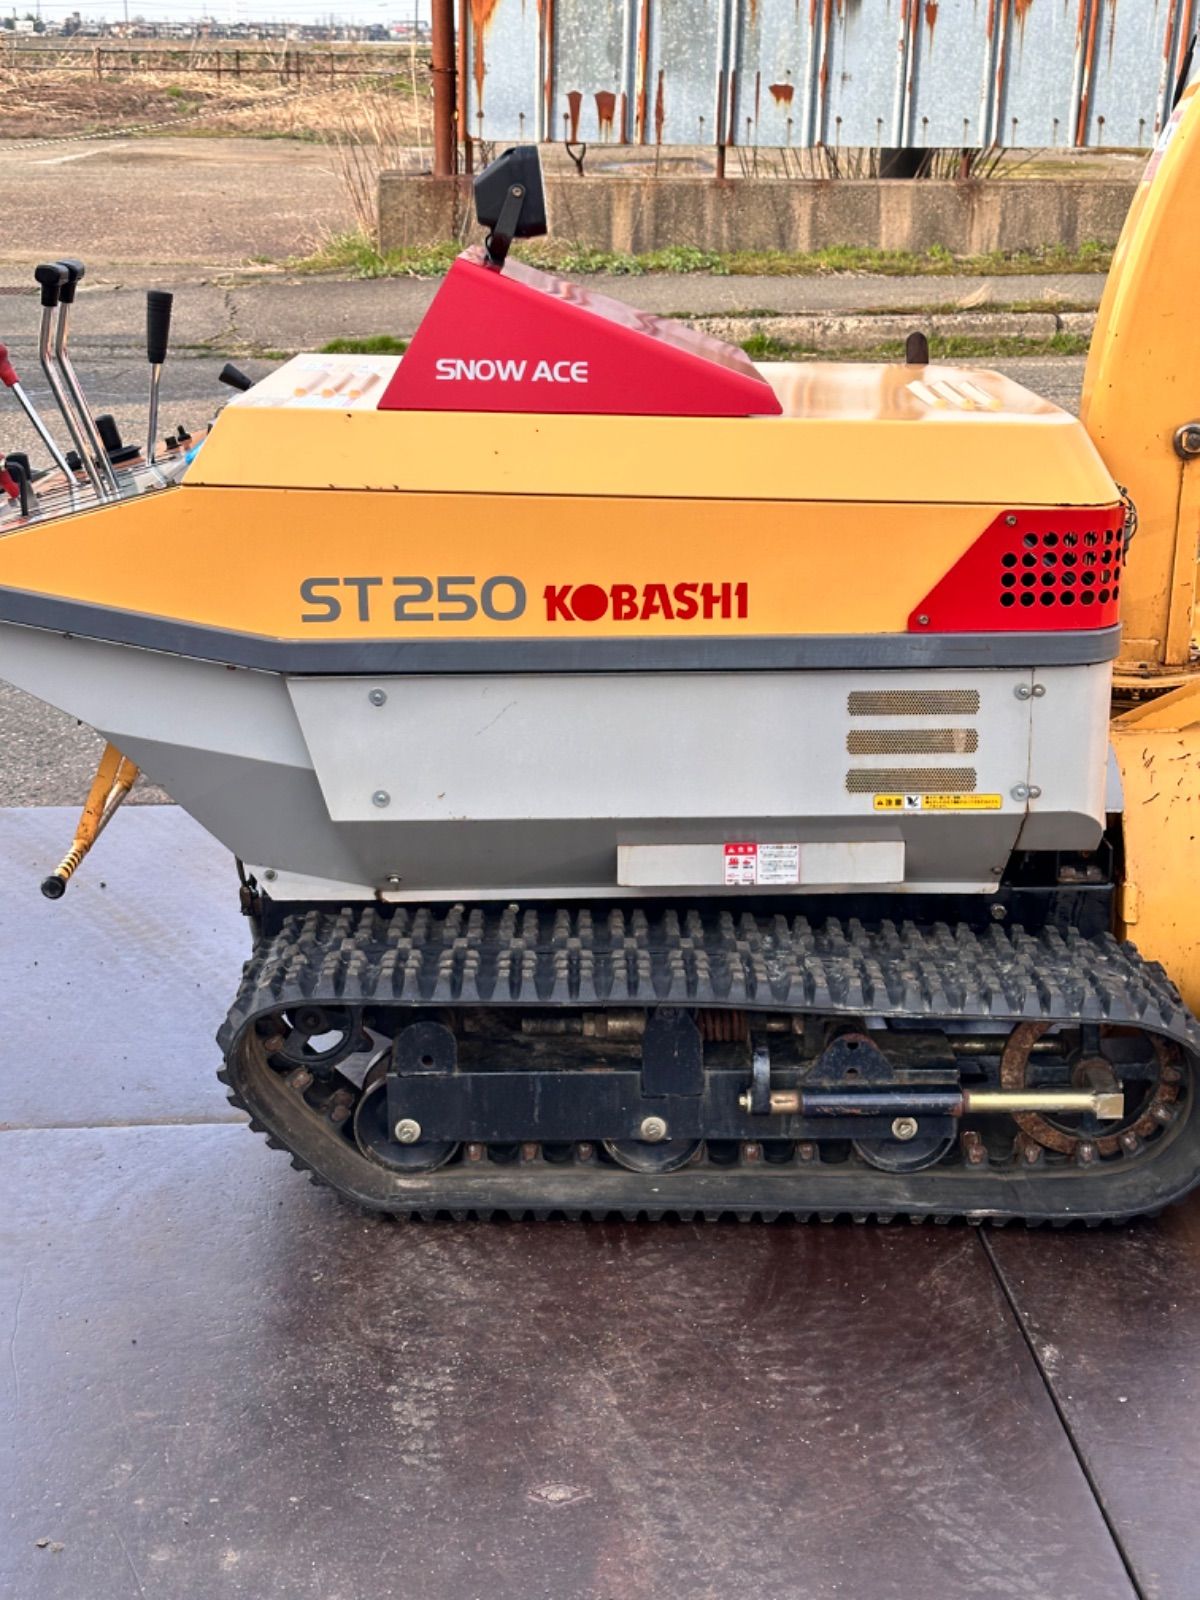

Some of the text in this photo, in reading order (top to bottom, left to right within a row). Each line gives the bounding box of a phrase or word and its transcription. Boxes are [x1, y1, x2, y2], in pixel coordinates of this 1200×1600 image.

[435, 358, 588, 383] SNOW ACE
[544, 582, 748, 621] KOBASHI
